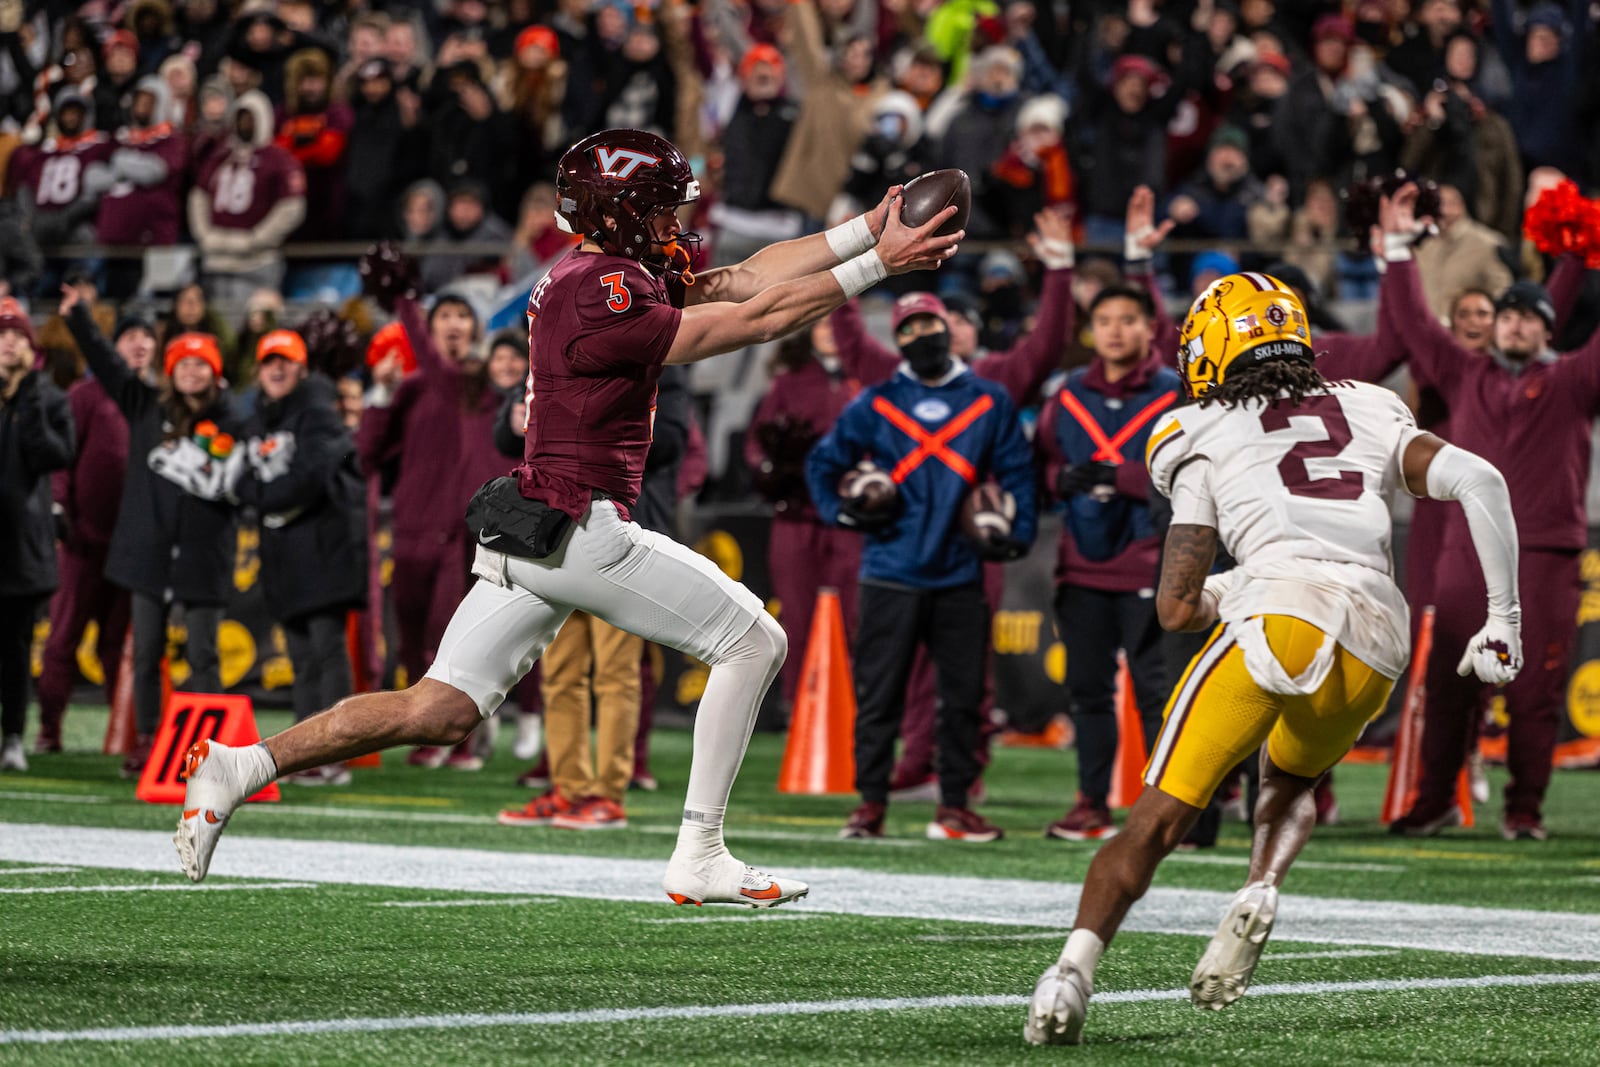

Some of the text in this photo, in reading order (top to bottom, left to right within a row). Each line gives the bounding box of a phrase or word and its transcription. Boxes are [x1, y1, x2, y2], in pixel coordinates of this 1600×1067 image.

[594, 146, 662, 181] VT
[600, 271, 632, 313] 3
[1254, 343, 1303, 360] SKI-U-MAH
[1259, 394, 1365, 501] 2
[155, 707, 228, 784] 10
